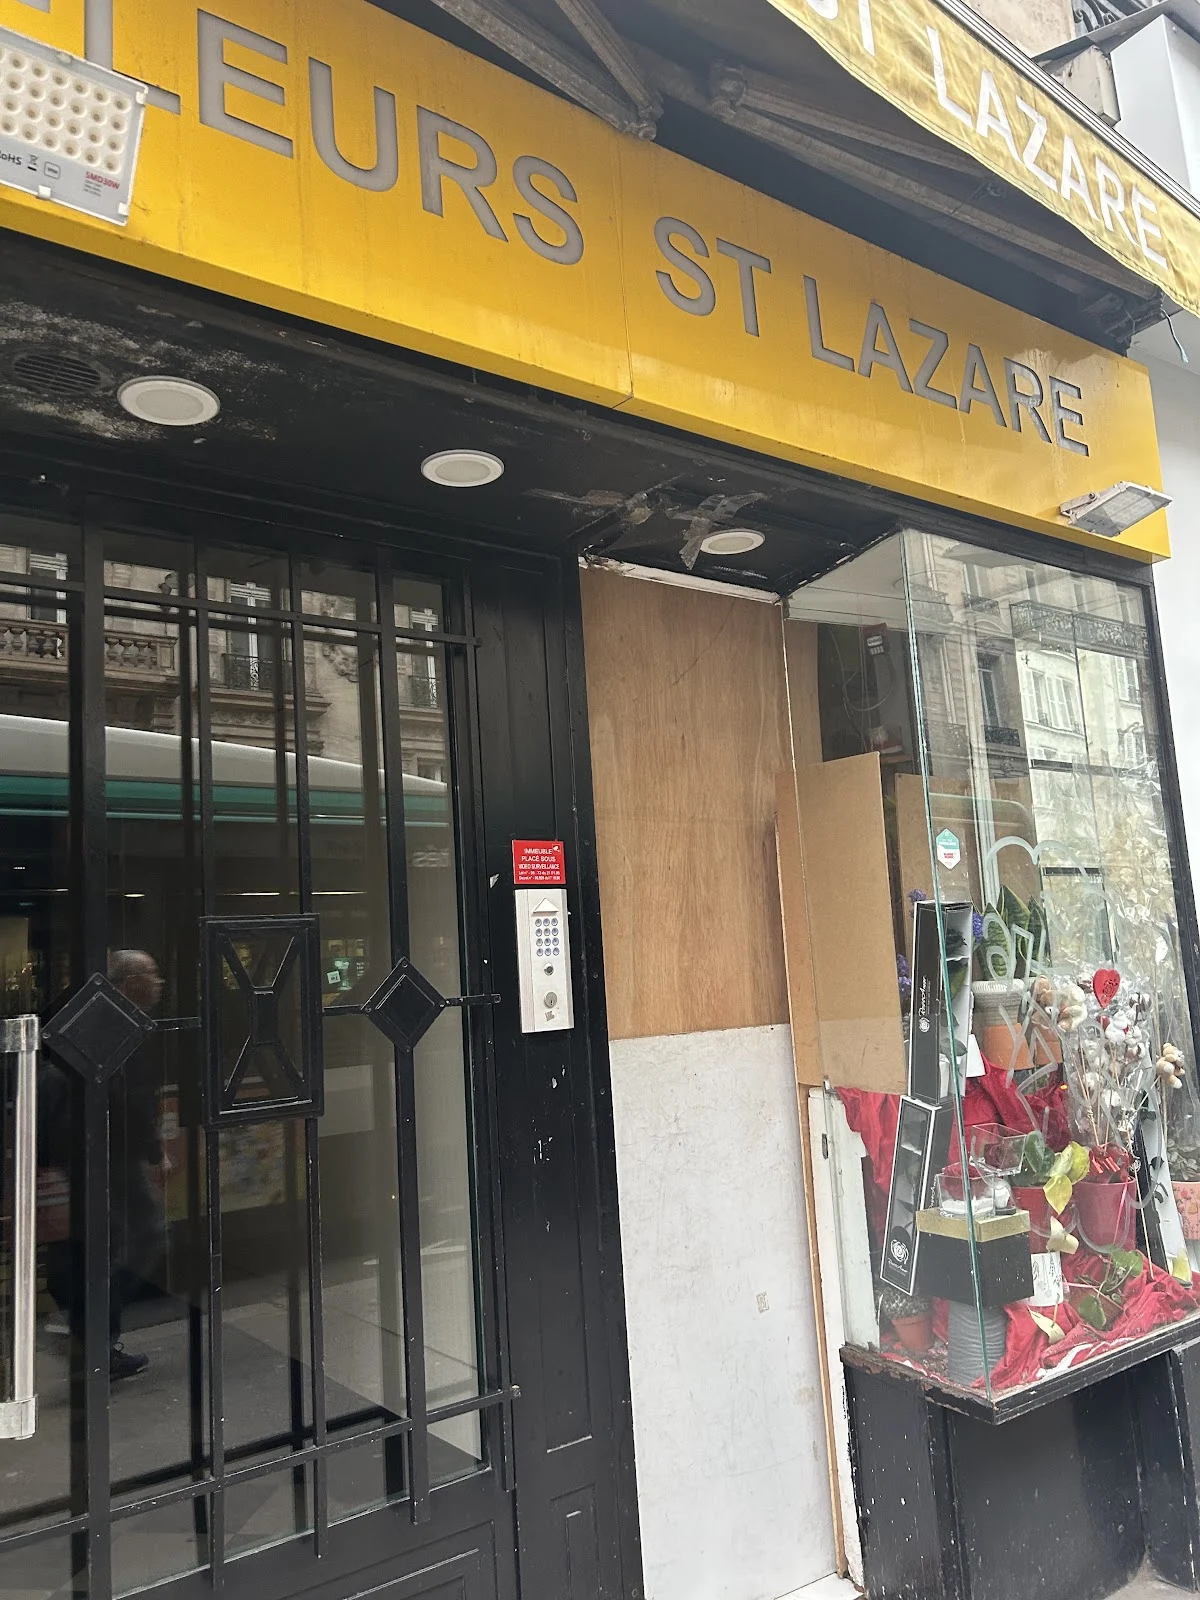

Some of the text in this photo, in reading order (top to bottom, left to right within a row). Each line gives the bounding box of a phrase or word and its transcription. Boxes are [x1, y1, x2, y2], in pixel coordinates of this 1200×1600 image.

[926, 25, 1169, 271] LAZARE
[0, 150, 22, 166] oHS
[85, 171, 120, 189] SMD30W
[18, 0, 1090, 458] LEURS ST LAZARE
[540, 855, 556, 863] SOUS
